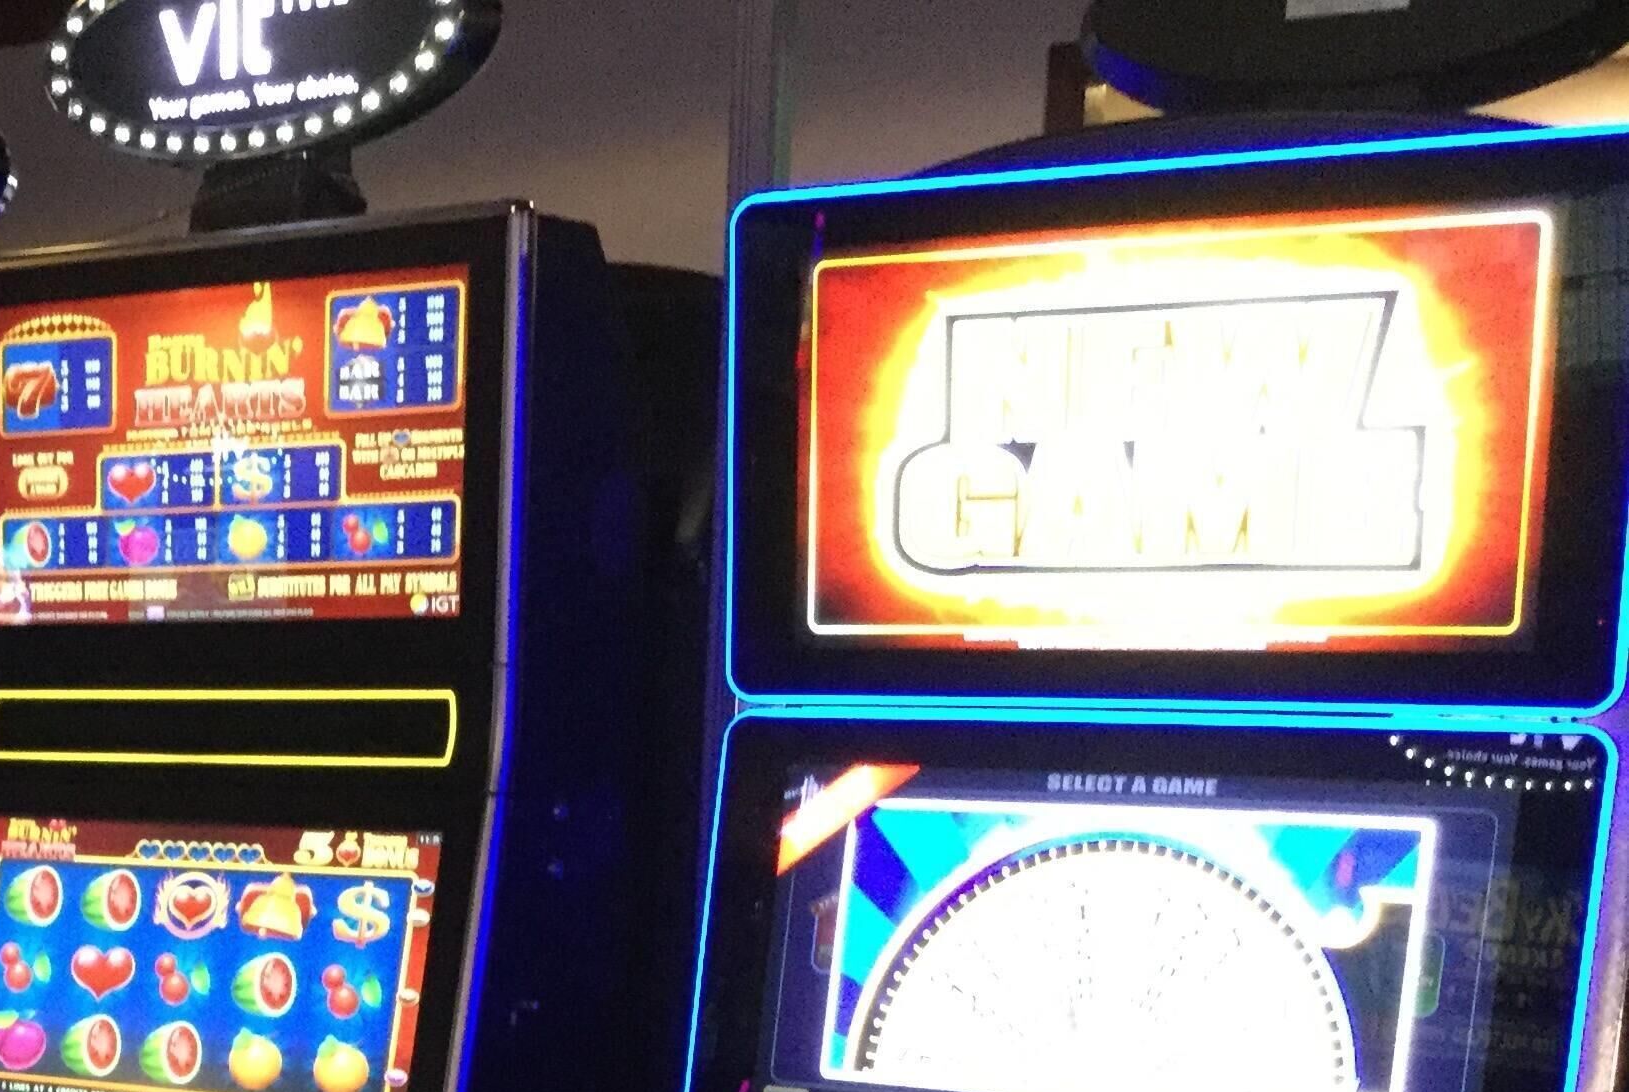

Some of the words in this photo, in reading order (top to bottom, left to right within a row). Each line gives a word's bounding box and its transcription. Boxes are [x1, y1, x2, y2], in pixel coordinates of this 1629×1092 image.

[431, 595, 459, 613] IGT
[1047, 772, 1127, 793] SELECT
[1131, 776, 1147, 793] A
[1152, 776, 1218, 796] GAME
